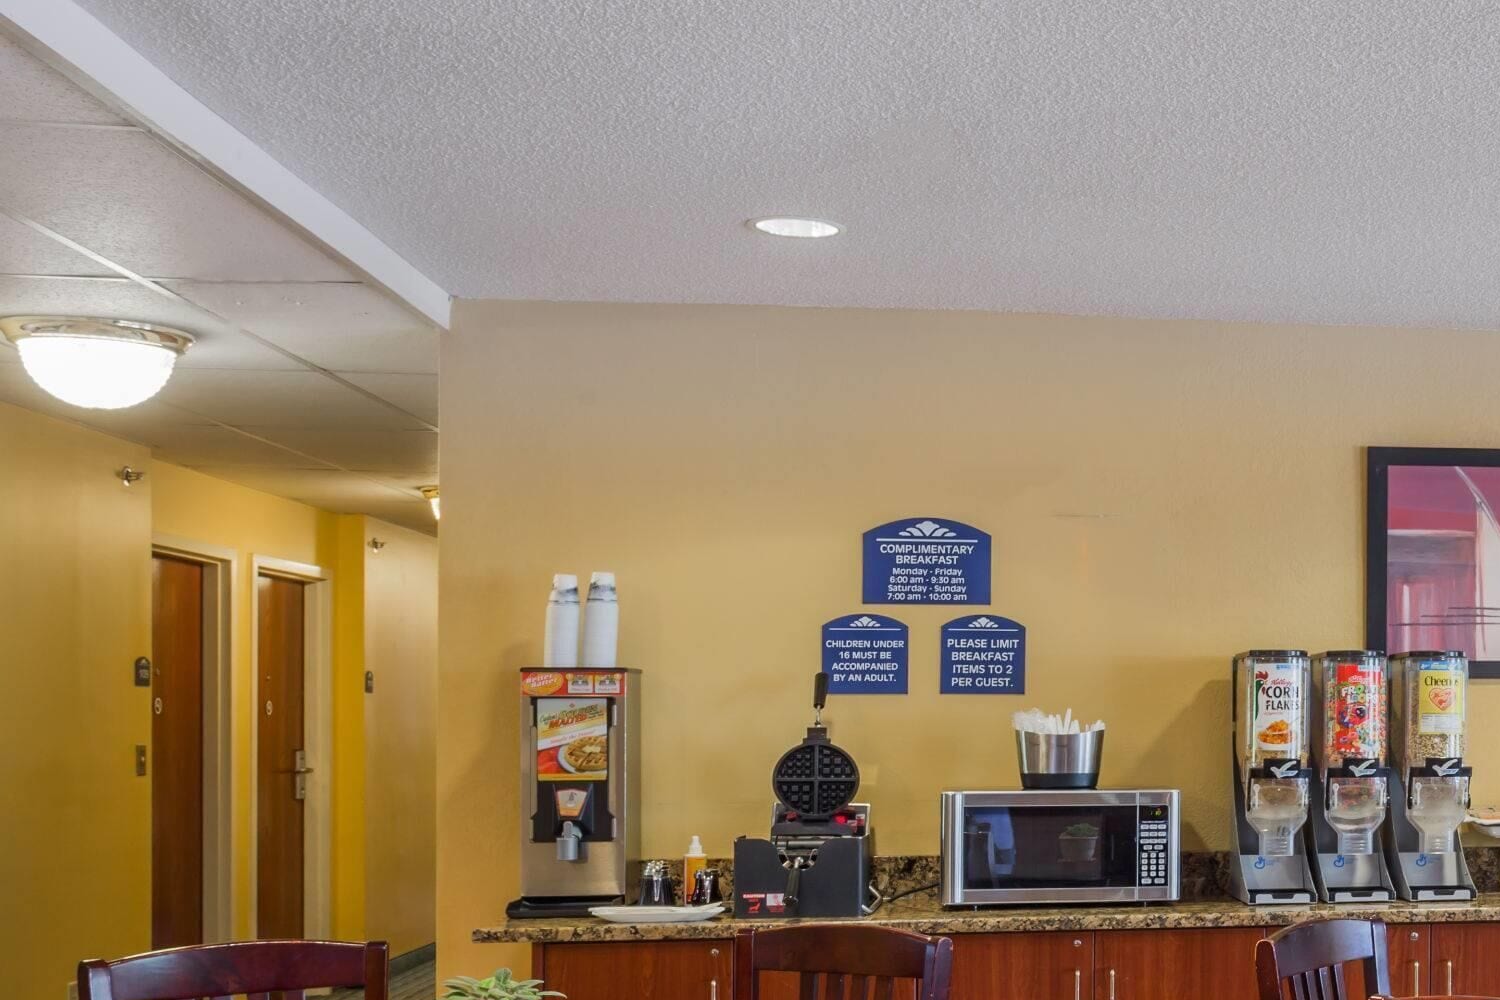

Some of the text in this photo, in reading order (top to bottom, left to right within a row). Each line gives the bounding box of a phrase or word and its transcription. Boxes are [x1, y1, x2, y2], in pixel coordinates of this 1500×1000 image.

[879, 544, 975, 555] COMPLIMENTARY
[895, 555, 959, 565] BREAKFAST
[892, 567, 928, 577] Monday
[934, 567, 963, 577] Friday
[889, 576, 909, 584] 6:00
[930, 576, 950, 584] 9:30
[887, 584, 928, 593] Saturday
[934, 584, 967, 594] Sunday
[887, 592, 906, 601] 7:00
[928, 593, 952, 601] 10:00
[825, 640, 905, 649] CHILDREN UNDER
[947, 639, 1020, 649] PLEASE LIMIT
[838, 651, 892, 660] 16 MUST BE
[951, 652, 1015, 661] BREAKFAST
[831, 662, 899, 671] ACCOMPANIED
[952, 665, 1013, 674] ITEMS TO 2
[833, 674, 897, 682] BY AN ADULT.
[951, 677, 1014, 687] PER GUEST.
[1424, 675, 1458, 687] Cheeris
[1265, 686, 1300, 699] CORN
